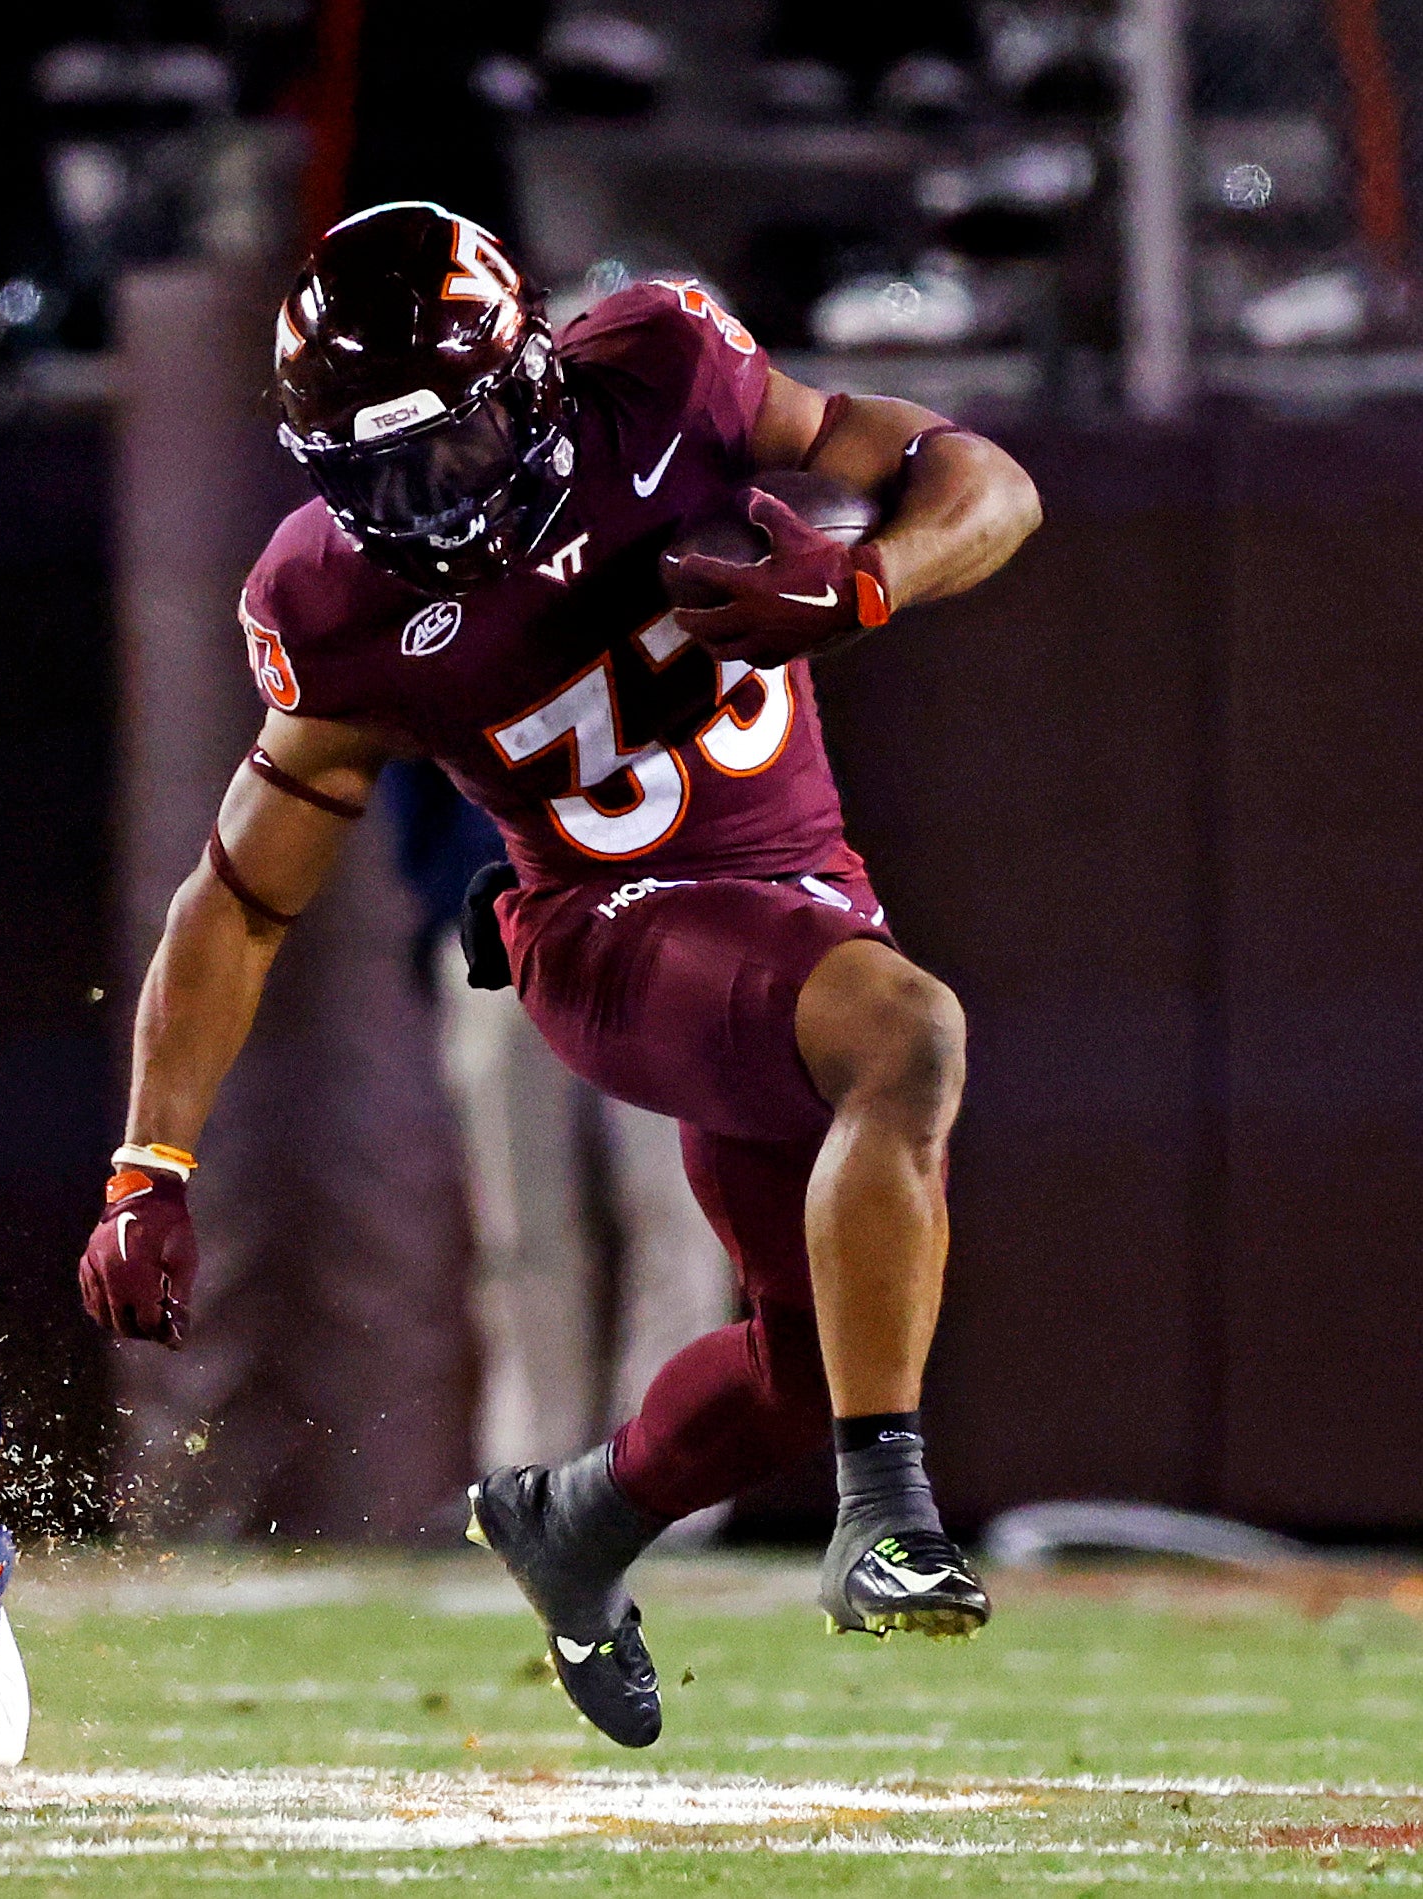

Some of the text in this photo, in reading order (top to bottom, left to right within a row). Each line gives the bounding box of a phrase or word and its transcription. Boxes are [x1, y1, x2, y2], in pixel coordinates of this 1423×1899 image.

[370, 405, 419, 429] TECH
[536, 531, 590, 583] VT
[412, 603, 454, 652] ACC
[483, 608, 795, 863] 33
